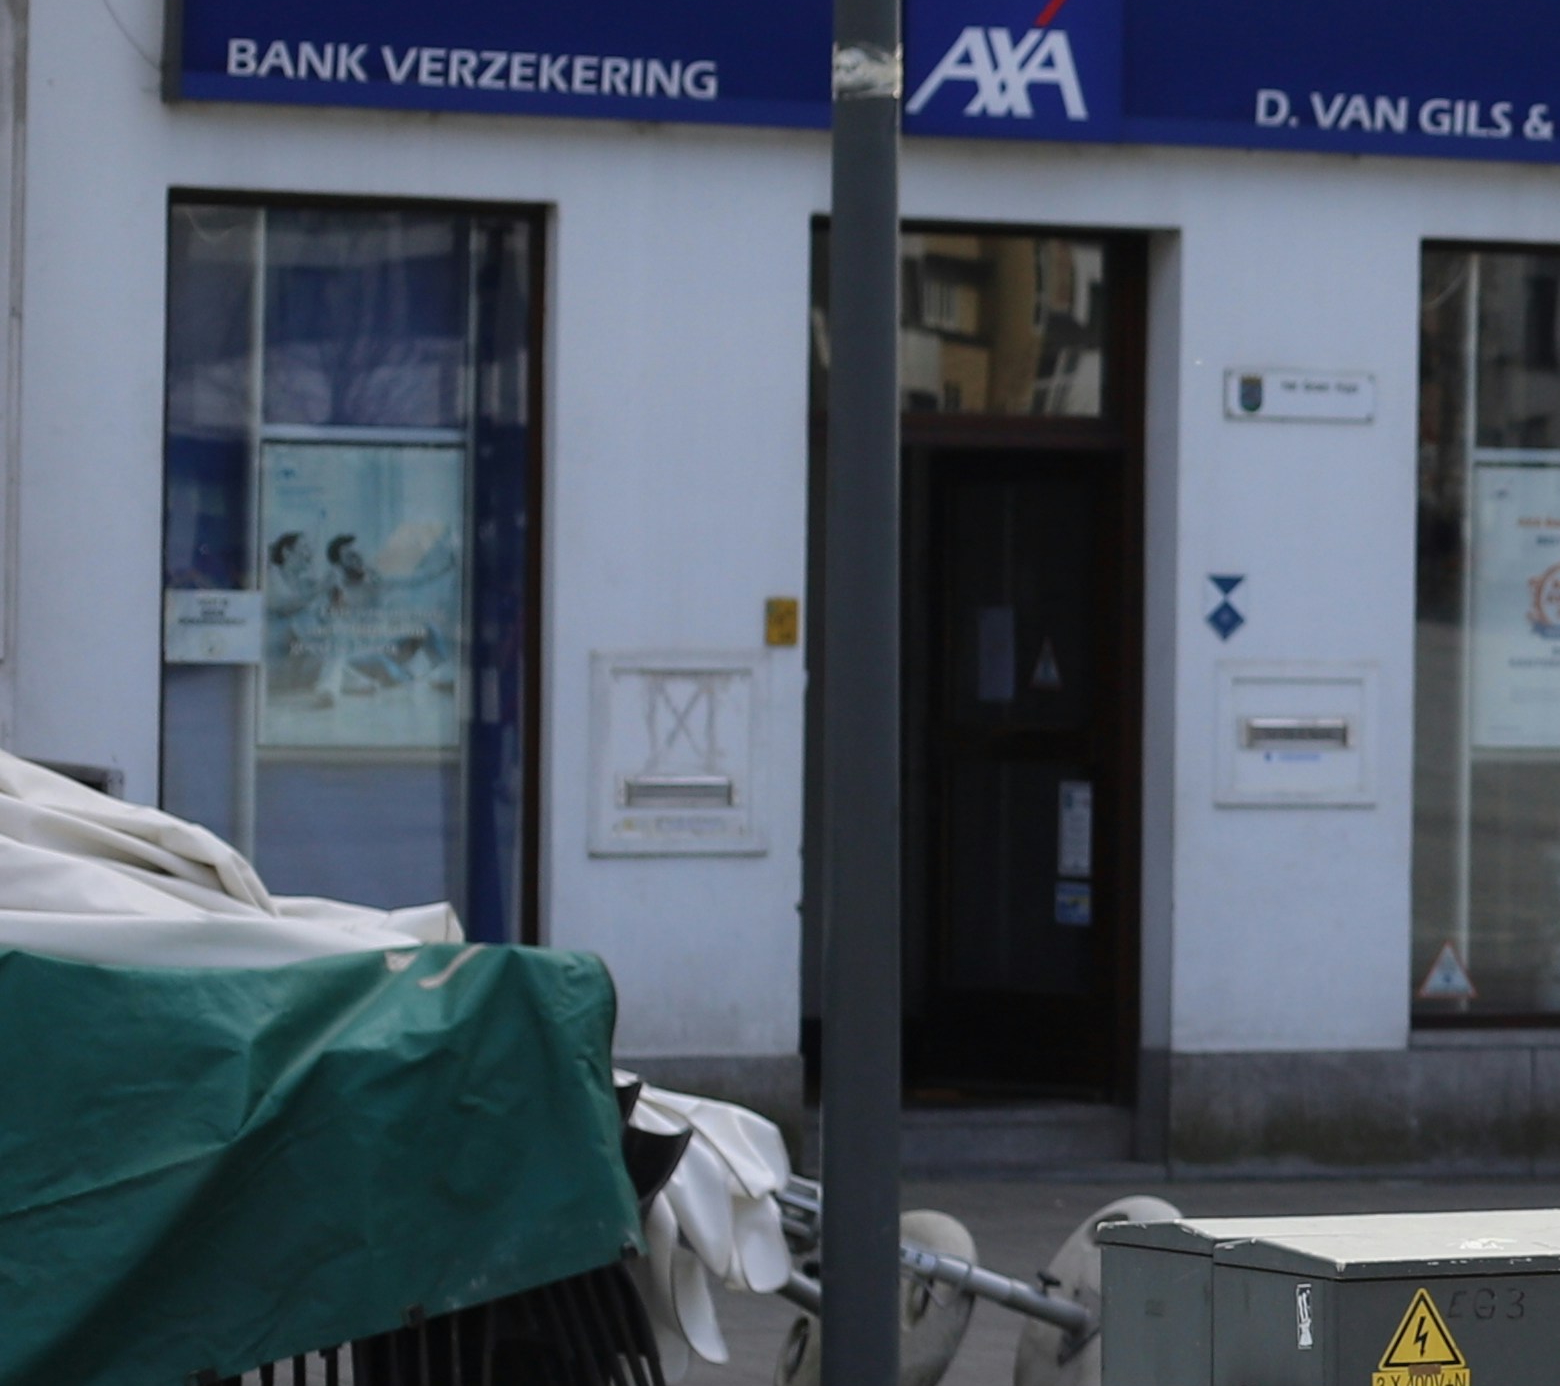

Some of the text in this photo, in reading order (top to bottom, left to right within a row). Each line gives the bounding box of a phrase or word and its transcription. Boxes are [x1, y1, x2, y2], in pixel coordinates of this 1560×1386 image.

[226, 38, 719, 101] BANK VERZEKERING
[905, 26, 1088, 121] AXA
[1256, 89, 1299, 128] D.
[1311, 93, 1409, 132] VAN
[1418, 98, 1512, 138] GILS
[1524, 104, 1554, 141] &
